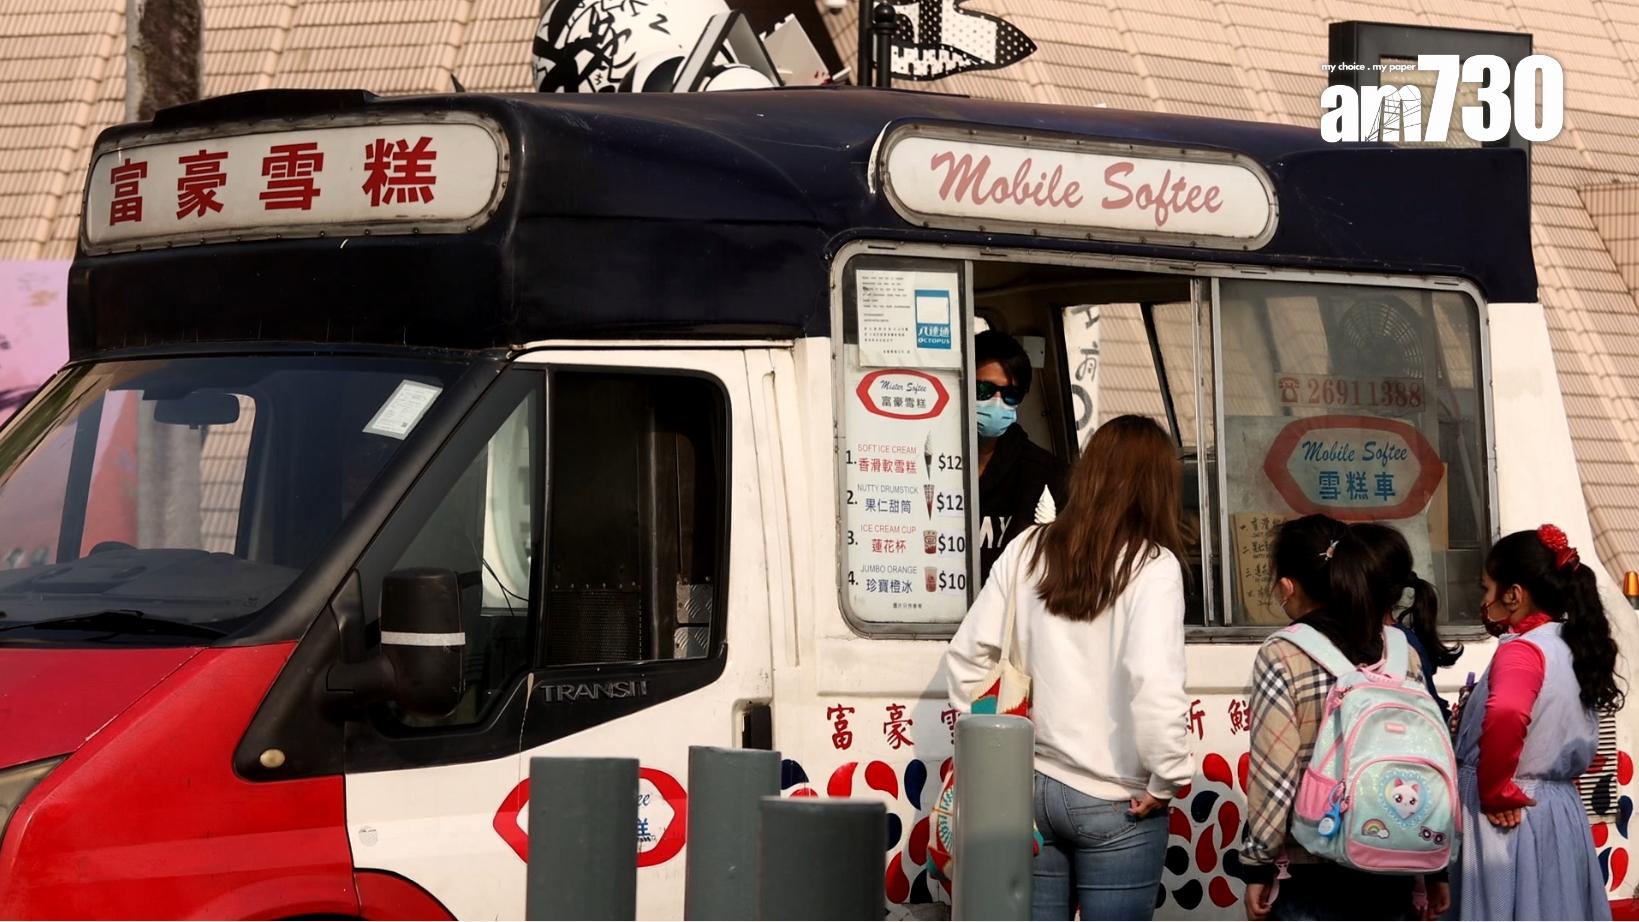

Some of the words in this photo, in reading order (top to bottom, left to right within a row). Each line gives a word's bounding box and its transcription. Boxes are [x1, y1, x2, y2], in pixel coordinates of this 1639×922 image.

[110, 136, 437, 226] 富豪雪糕
[930, 151, 1084, 208] Mobile
[1101, 161, 1224, 227] Softee
[918, 325, 950, 338] 八達通
[918, 337, 950, 345] OCTOPUS
[858, 444, 877, 452] SOFT
[878, 445, 890, 453] ICE
[892, 446, 917, 454] CREAM
[1302, 440, 1355, 462] Mobile
[1362, 441, 1408, 467] Softee
[846, 450, 857, 465] 1.
[859, 458, 917, 474] 香滑軟雪糕
[939, 453, 962, 472] $12
[858, 484, 879, 493] NUTTY
[881, 485, 918, 494] DRUMSTICK
[1319, 471, 1396, 501] 雪糕車
[846, 490, 858, 505] 2.
[865, 498, 911, 514] 果仁甜筒
[937, 492, 964, 513] $12
[861, 524, 873, 533] ICE
[875, 525, 900, 533] CREAM
[901, 526, 917, 534] CUP
[872, 538, 907, 554] 蓮花杯
[938, 533, 965, 554] $10
[861, 565, 886, 574] JUMBO
[887, 565, 917, 574] ORANGE
[866, 579, 912, 594] 珍寶橙冰
[939, 570, 966, 591] $10
